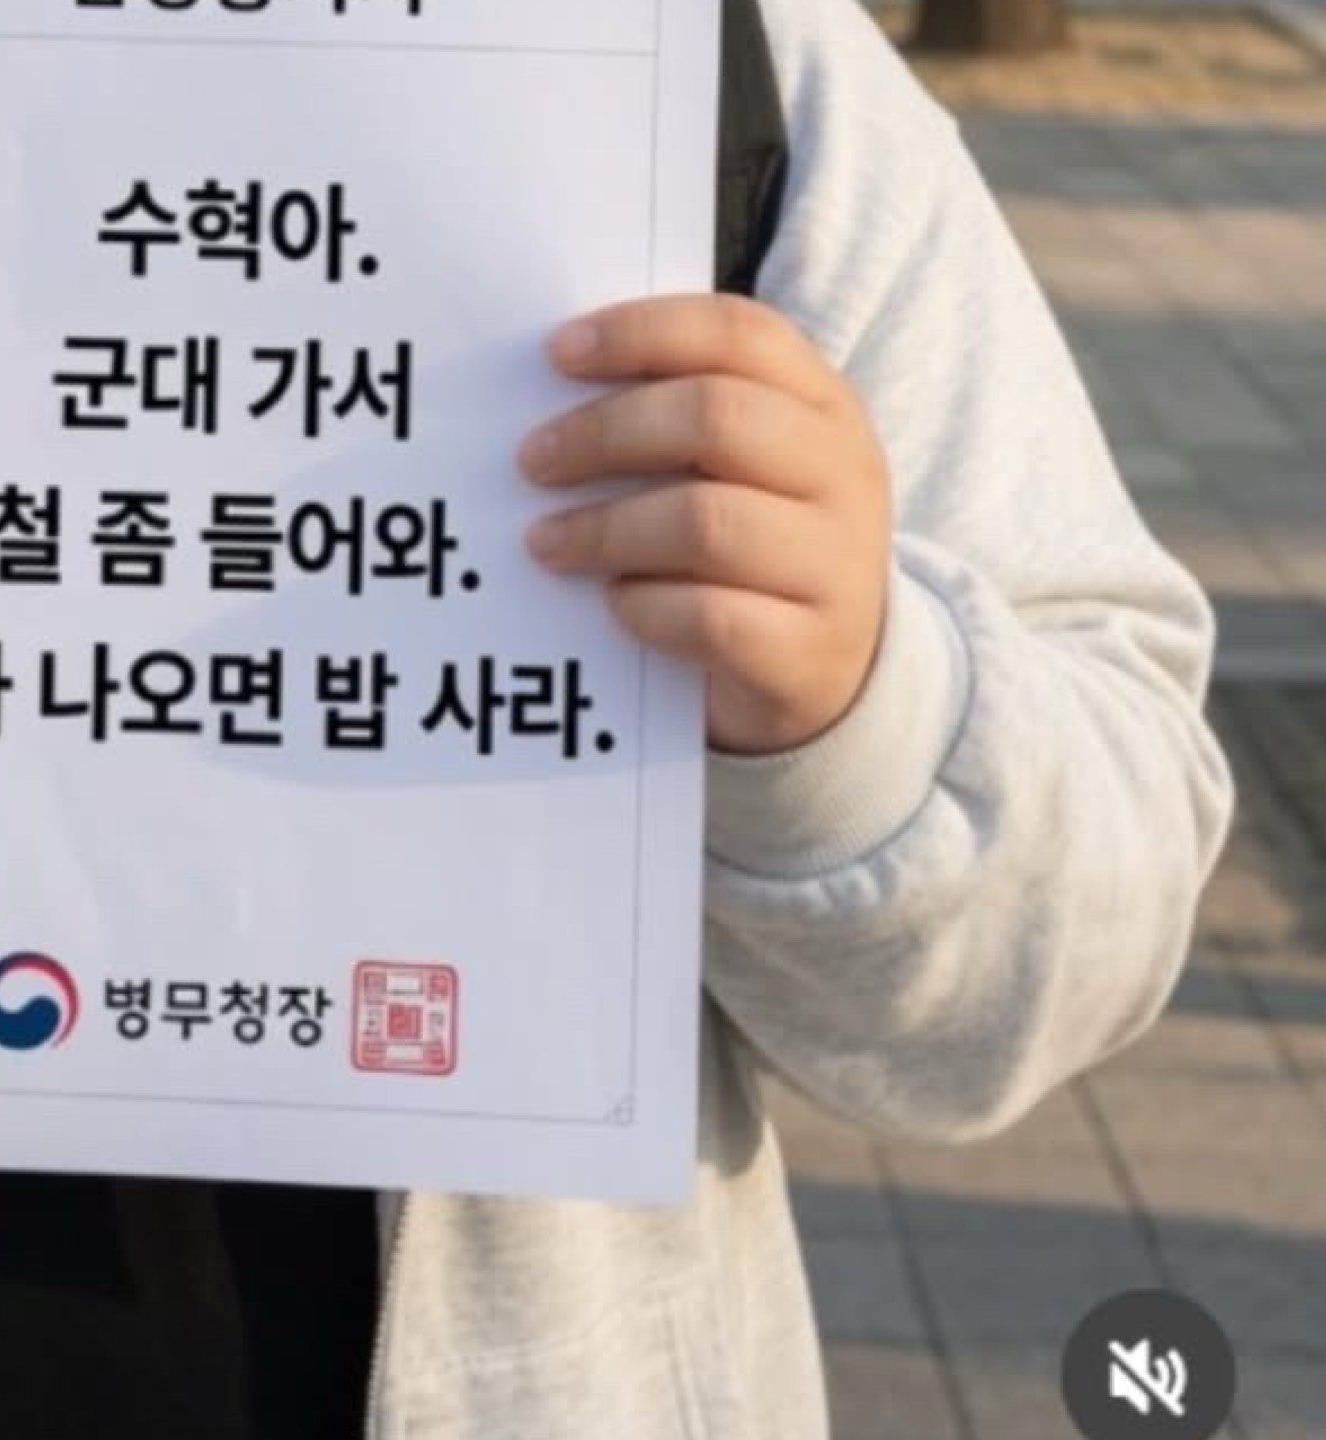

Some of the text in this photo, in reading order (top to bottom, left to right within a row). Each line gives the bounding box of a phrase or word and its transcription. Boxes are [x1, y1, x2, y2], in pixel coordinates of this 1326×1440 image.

[97, 177, 380, 286] 수혁아.
[52, 335, 414, 443] 군대 가서
[91, 490, 176, 587] 좀
[199, 493, 482, 599] 들어와.
[39, 642, 284, 747] 나오면
[315, 652, 399, 751] 밥
[420, 655, 617, 760] 사라.
[103, 977, 334, 1049] 병무청장
